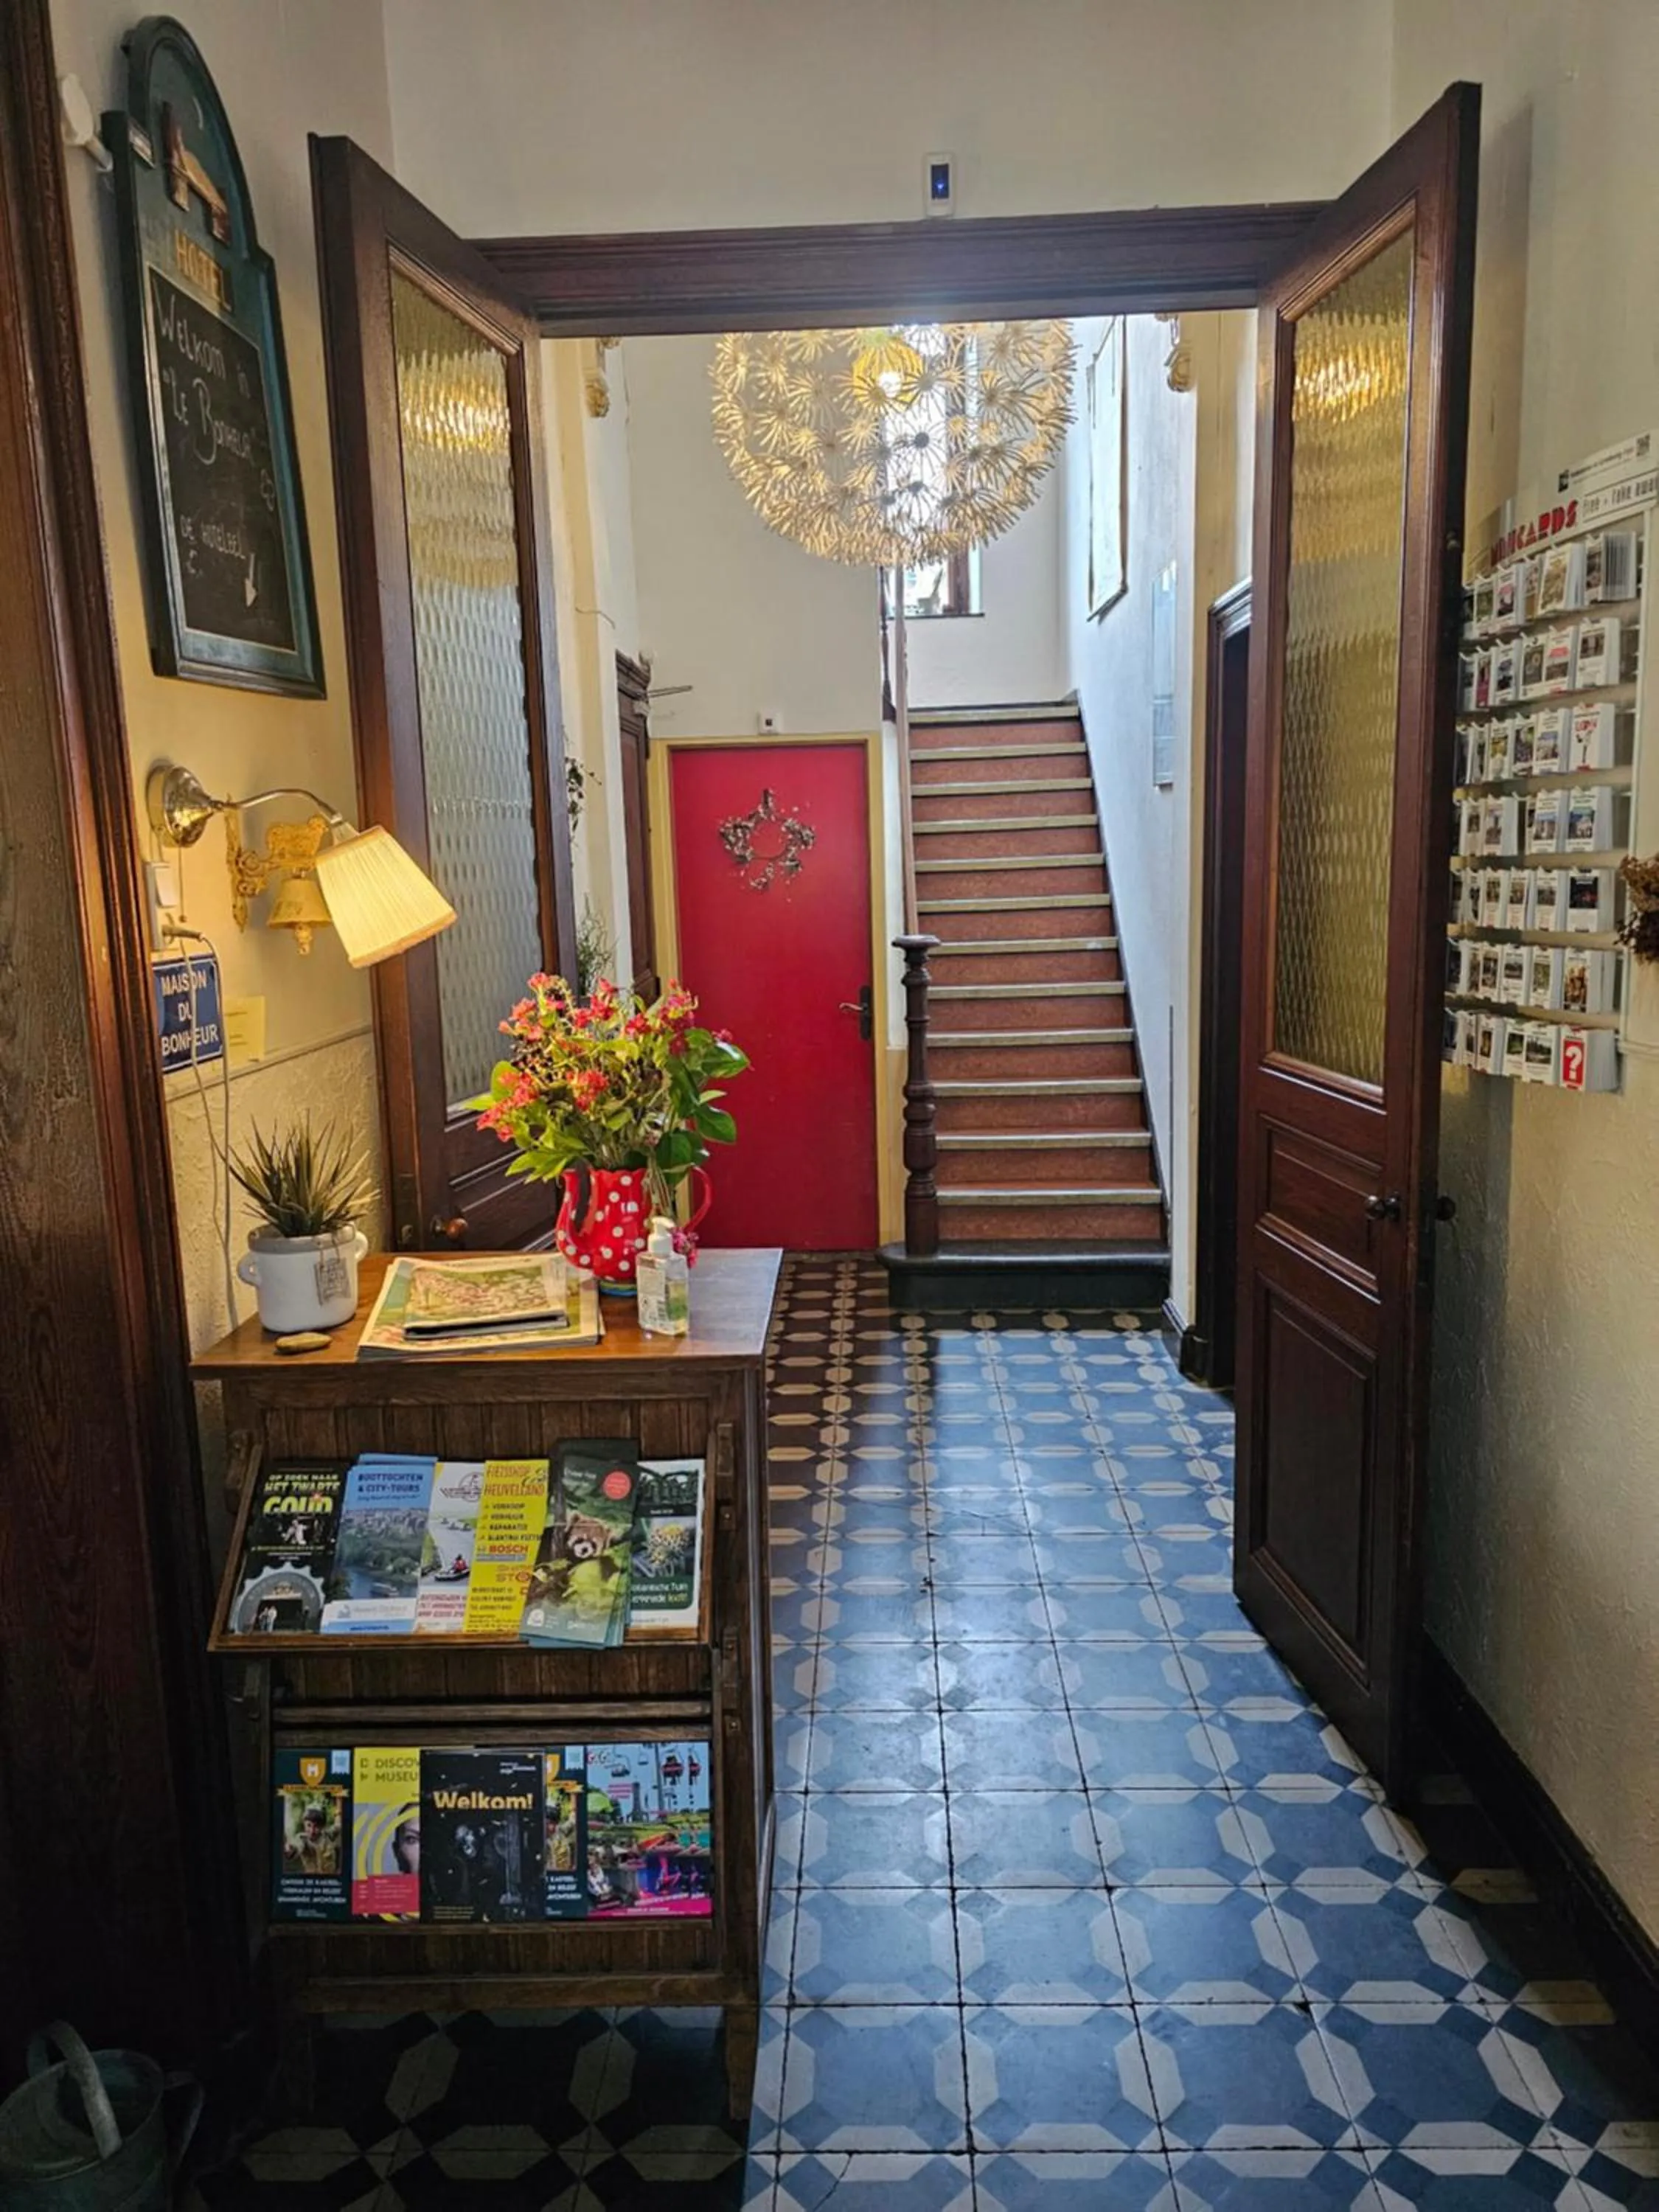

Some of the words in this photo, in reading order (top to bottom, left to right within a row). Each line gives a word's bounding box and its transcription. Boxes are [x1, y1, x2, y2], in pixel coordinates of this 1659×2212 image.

[175, 230, 232, 312] HOTEL
[161, 970, 207, 995] MAISON
[161, 1024, 219, 1056] BONHEUR
[489, 1545, 529, 1554] BOSCH
[433, 1790, 534, 1809] Welkom!
